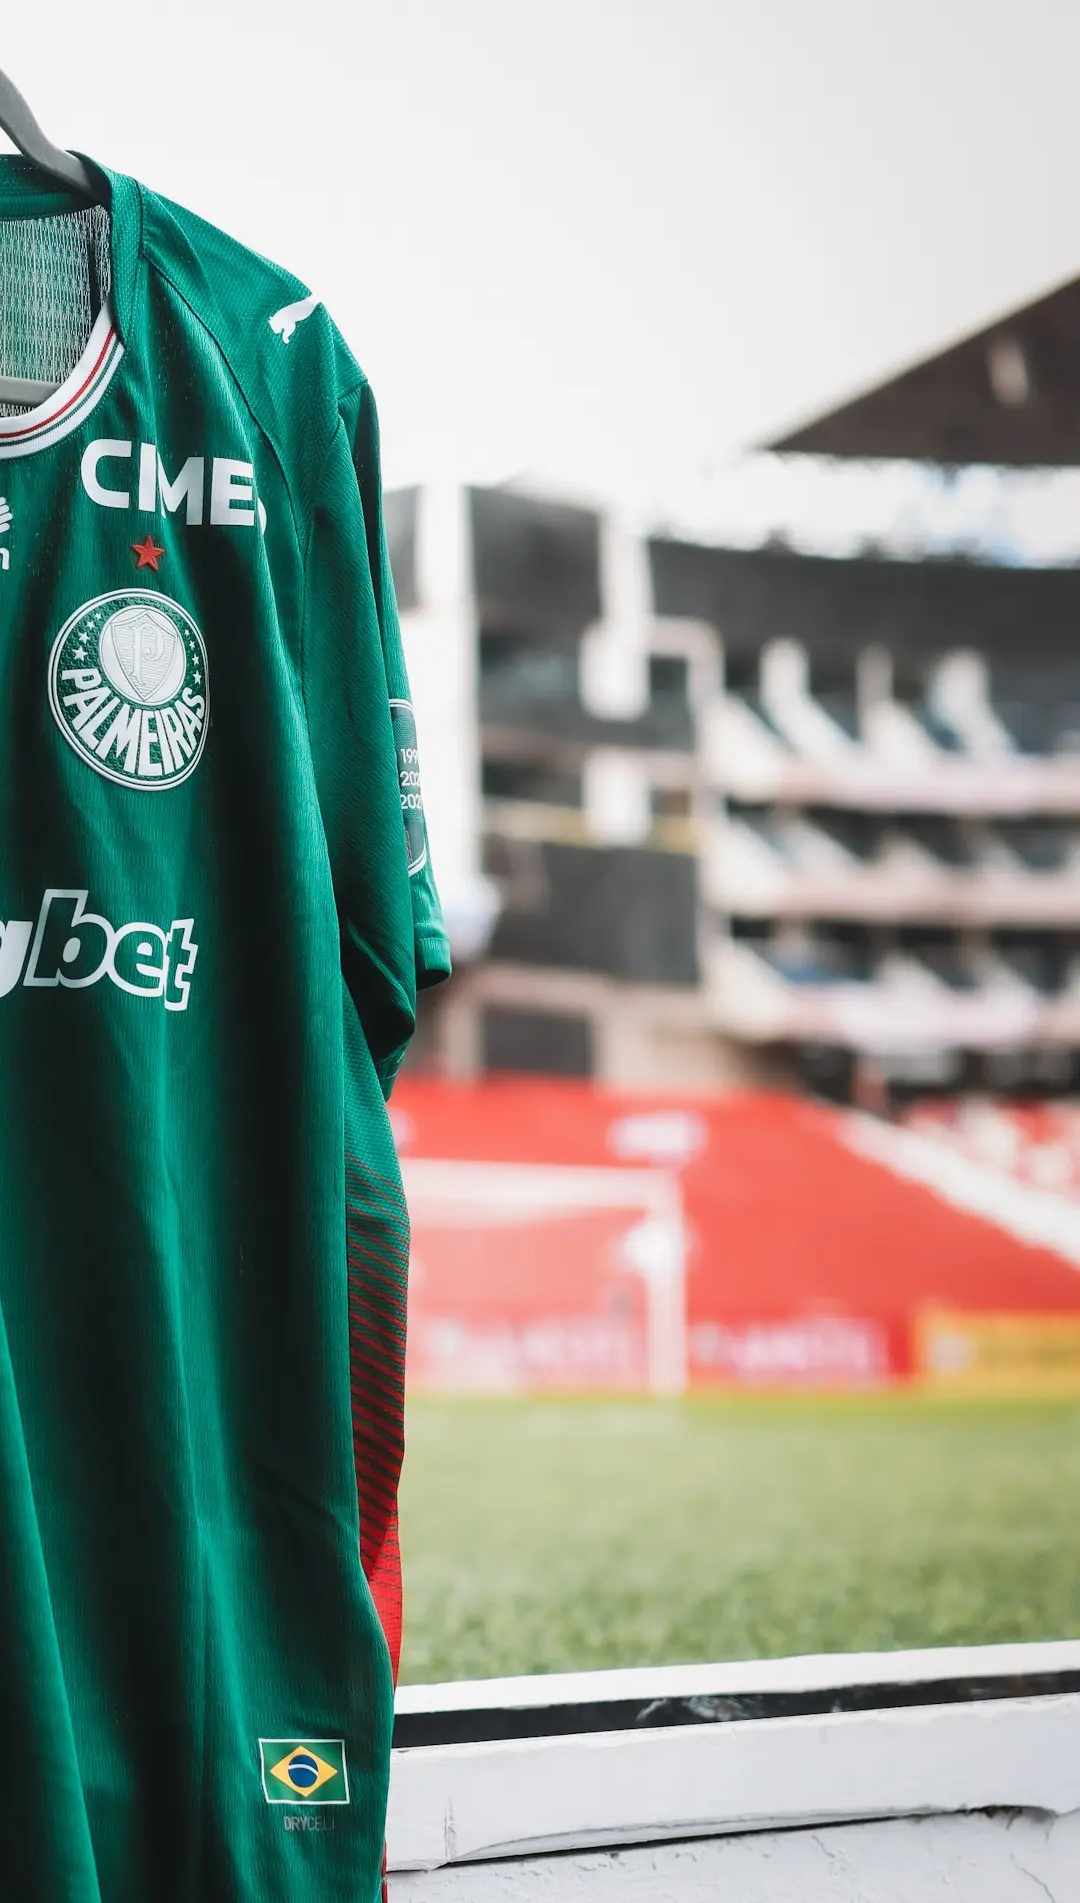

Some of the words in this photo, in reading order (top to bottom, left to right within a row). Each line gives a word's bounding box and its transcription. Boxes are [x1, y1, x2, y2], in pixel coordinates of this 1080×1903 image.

[81, 438, 267, 536] CIME
[62, 667, 205, 776] PALMEIRAS
[400, 748, 419, 764] 199
[400, 770, 421, 787] 202
[400, 793, 422, 810] 202
